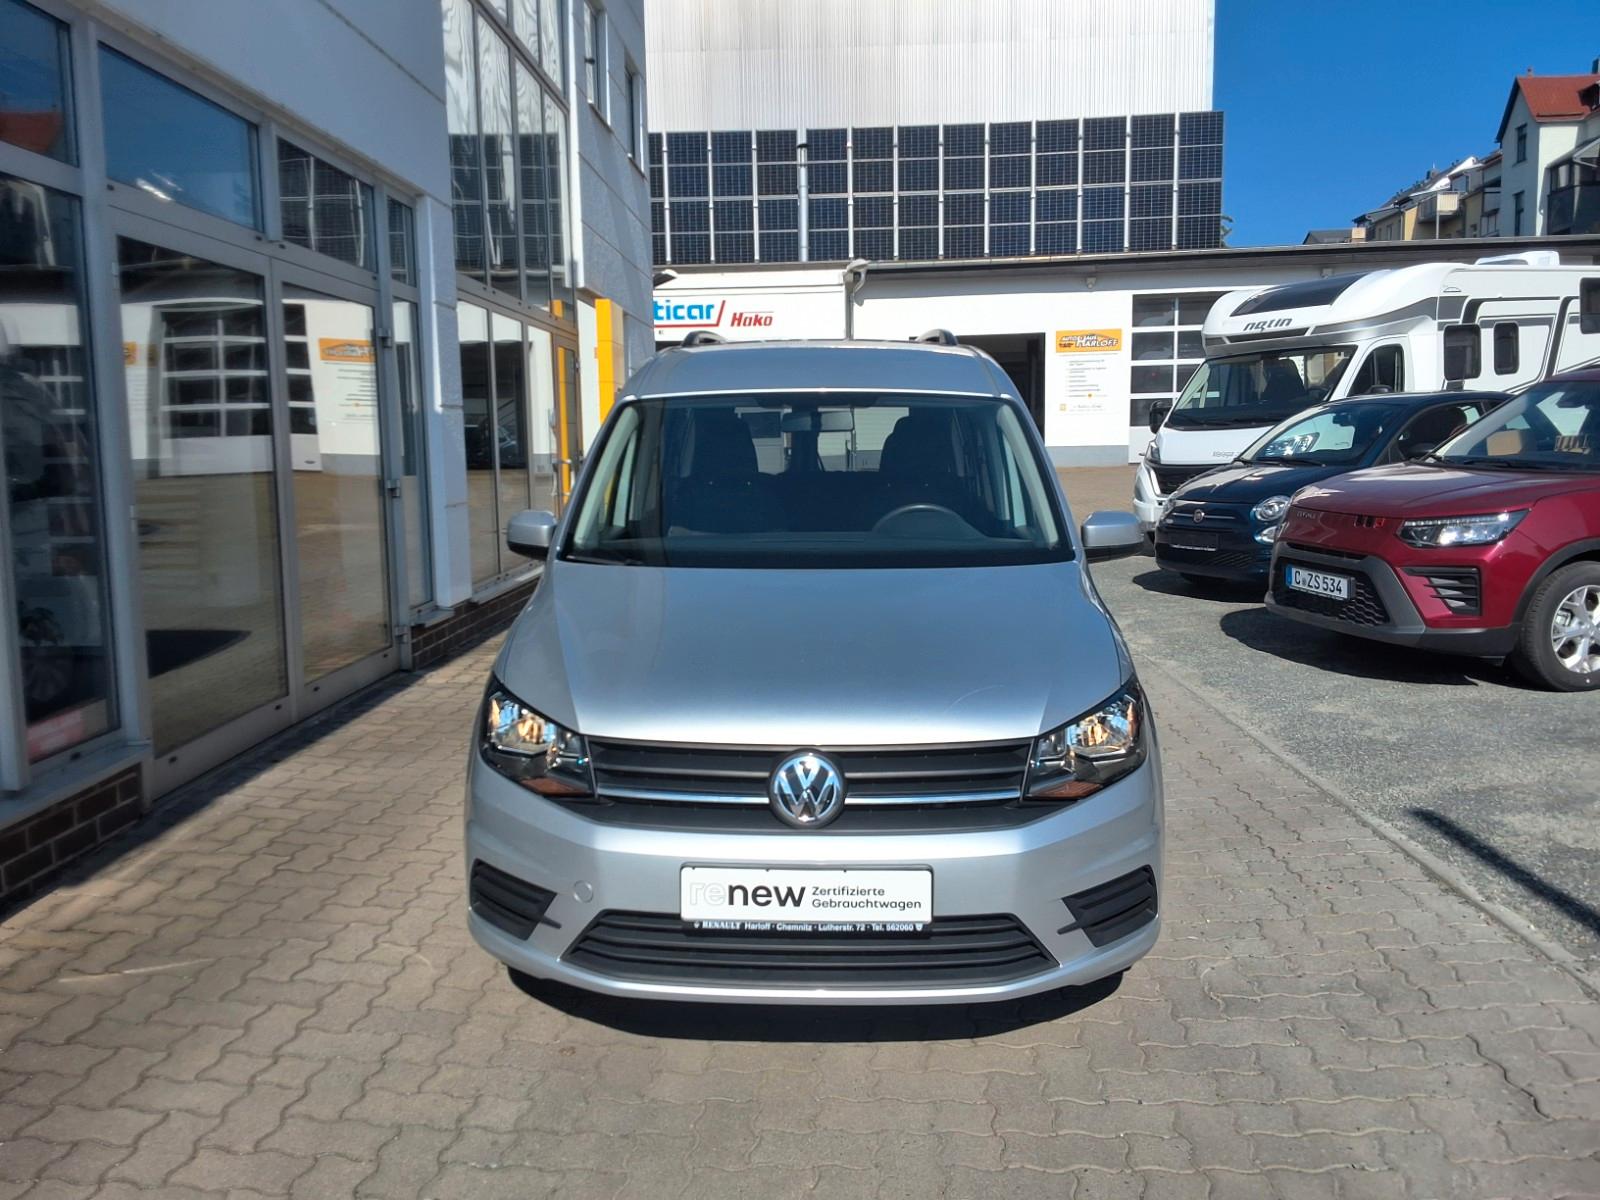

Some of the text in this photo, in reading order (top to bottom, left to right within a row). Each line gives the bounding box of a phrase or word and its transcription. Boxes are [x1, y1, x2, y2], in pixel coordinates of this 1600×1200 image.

[730, 312, 774, 328] Hako
[1294, 570, 1301, 585] C
[1307, 573, 1320, 590] ZS
[1322, 577, 1342, 595] 534
[811, 886, 886, 897] Zertifizierte
[811, 899, 922, 911] Gebrauchtwagen
[702, 921, 740, 930] RENAULT
[744, 922, 771, 931] Harloff
[776, 922, 812, 931] Chemnitz
[872, 923, 885, 932] Tel.
